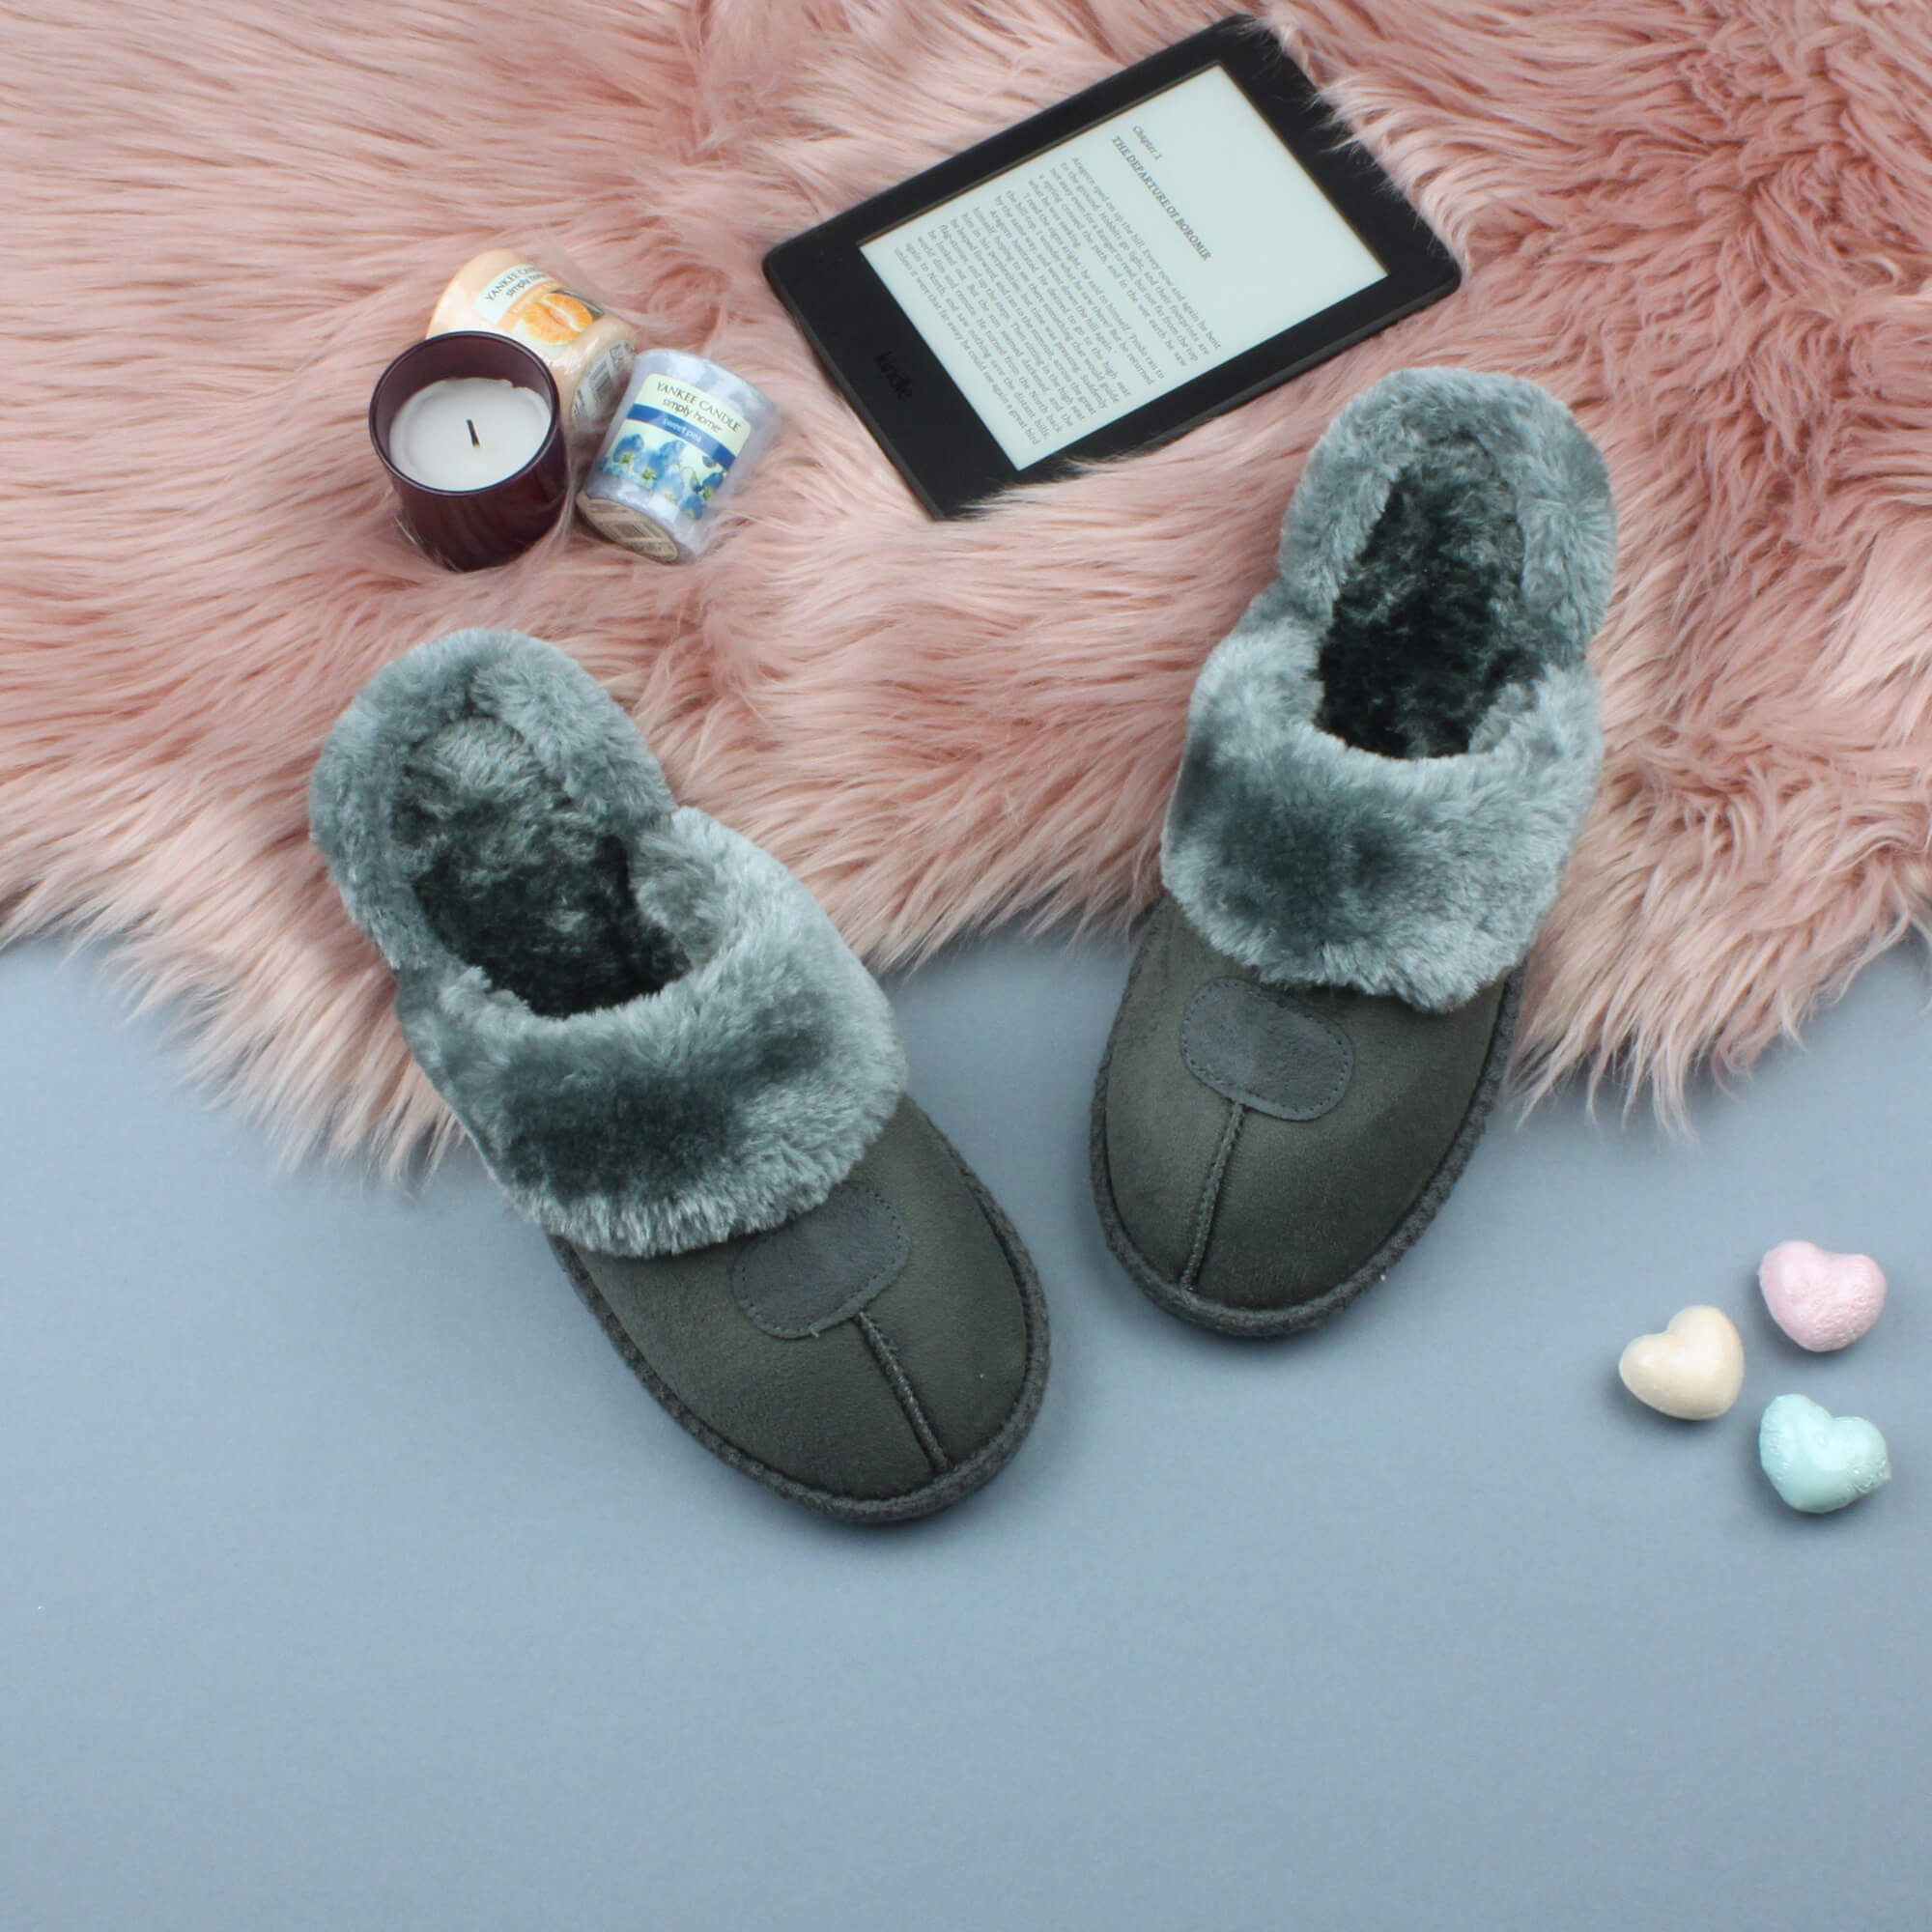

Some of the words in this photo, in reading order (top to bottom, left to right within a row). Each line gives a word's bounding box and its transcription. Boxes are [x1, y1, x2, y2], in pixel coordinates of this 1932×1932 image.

[1110, 134, 1132, 156] THE
[1124, 154, 1171, 208] DEPARTURE
[1164, 204, 1180, 220] OF
[1174, 217, 1212, 262] BOROMIR
[484, 272, 519, 300] YANKEE
[657, 382, 697, 404] YANKEE
[699, 401, 741, 432] CANDLE
[663, 398, 693, 418] simply
[694, 412, 723, 433] home
